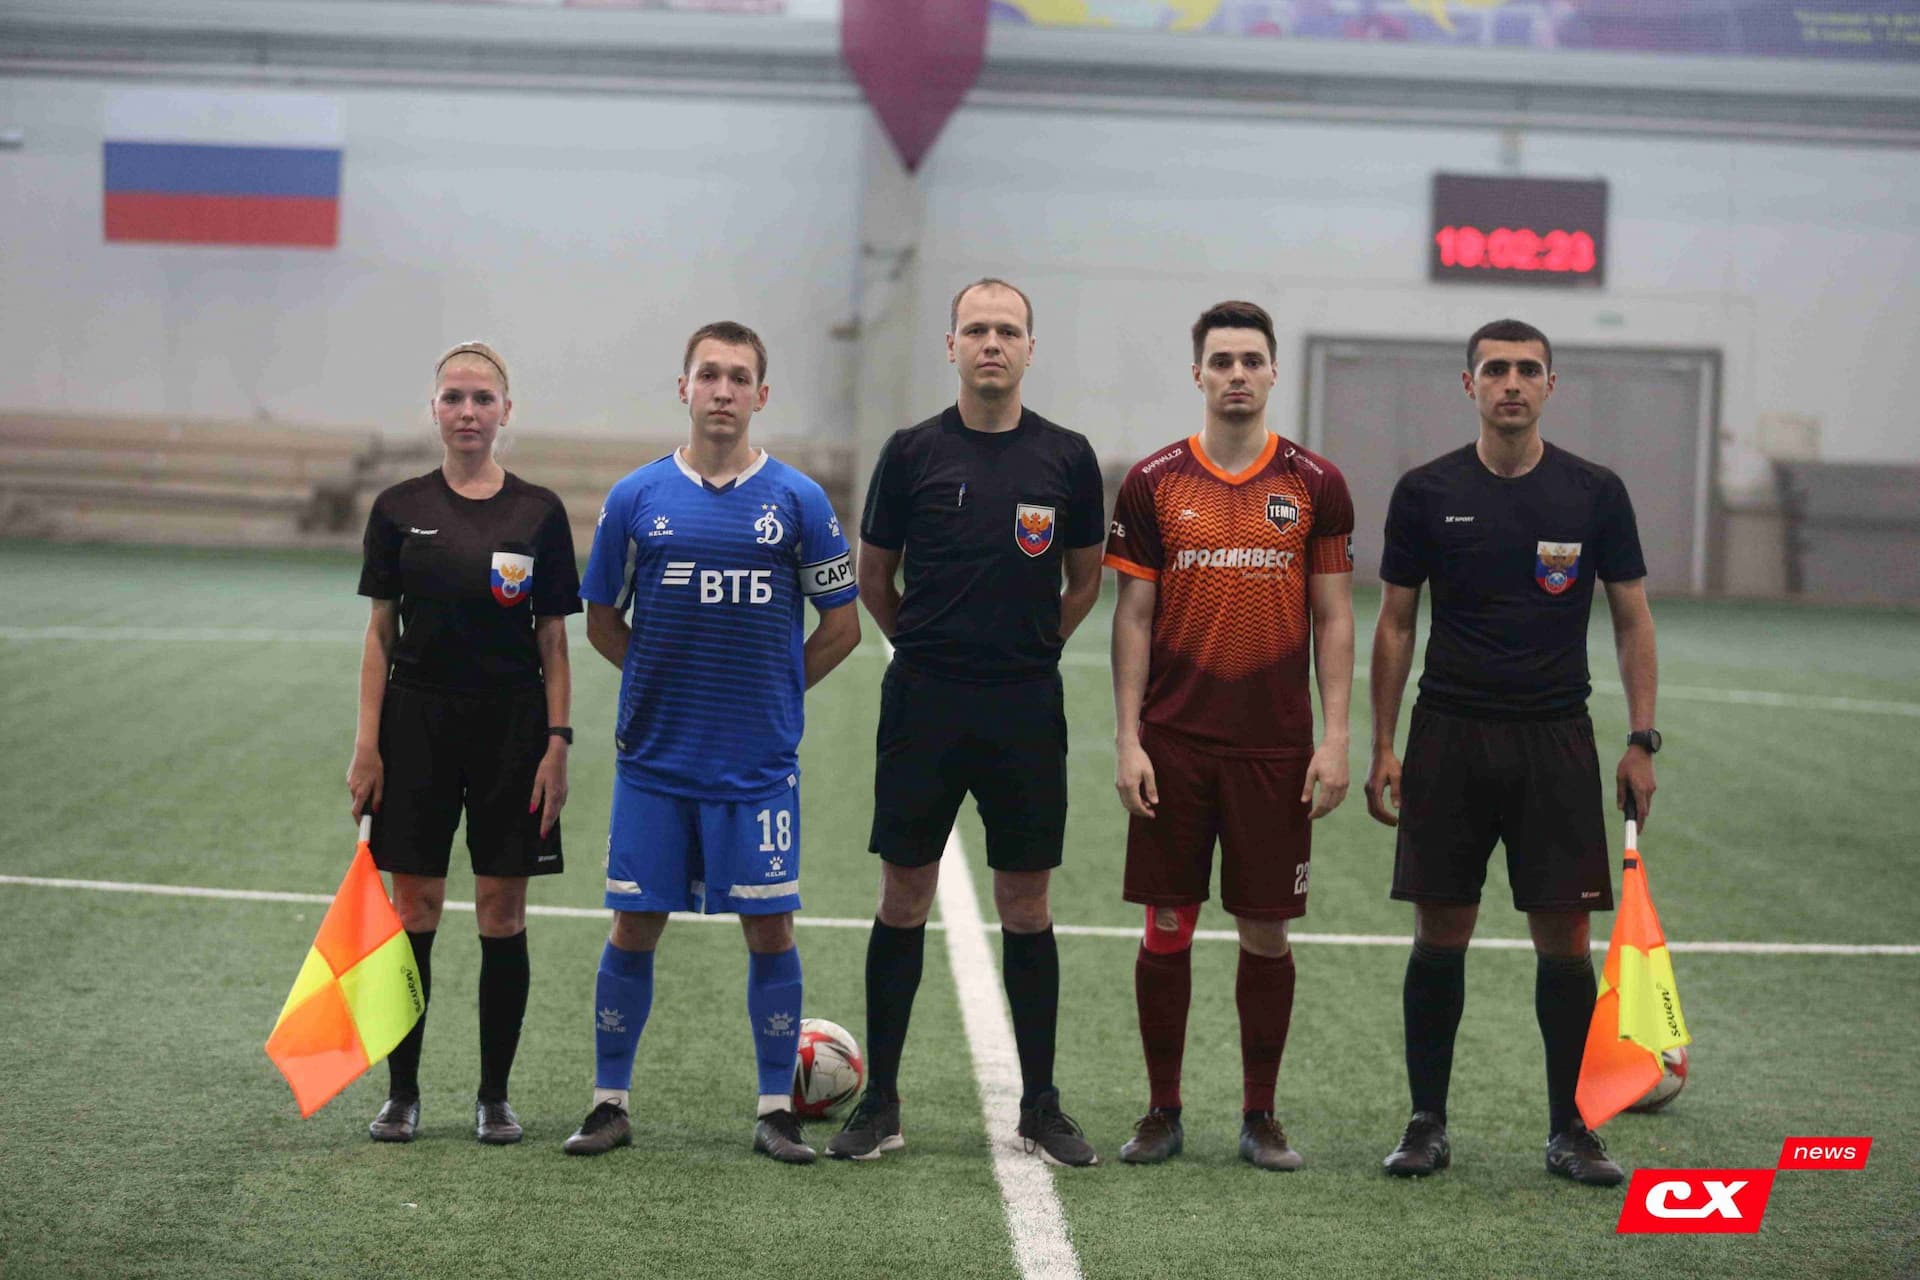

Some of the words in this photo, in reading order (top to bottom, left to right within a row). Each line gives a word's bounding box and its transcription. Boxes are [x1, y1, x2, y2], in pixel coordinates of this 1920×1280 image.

[1269, 504, 1297, 521] ТЕМП
[700, 569, 773, 604] ВТБ
[756, 809, 792, 852] 18
[1661, 988, 1681, 1038] seven
